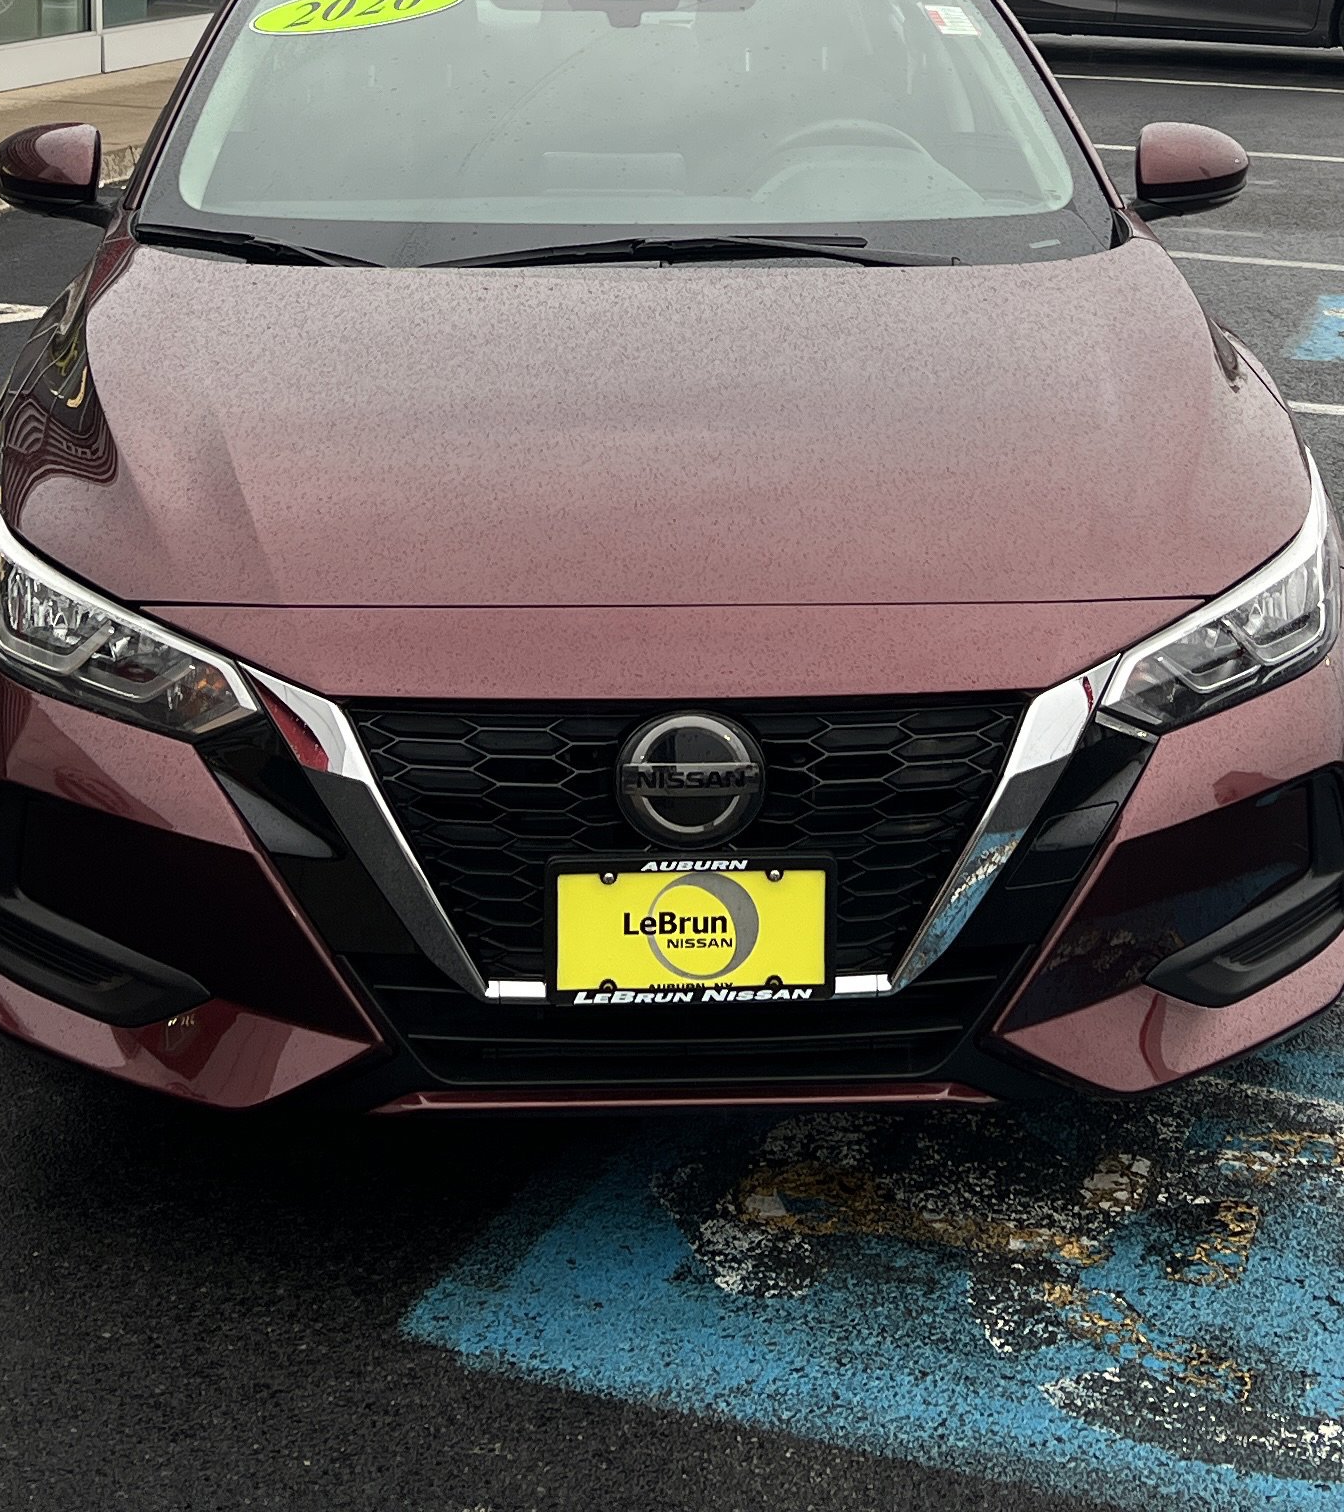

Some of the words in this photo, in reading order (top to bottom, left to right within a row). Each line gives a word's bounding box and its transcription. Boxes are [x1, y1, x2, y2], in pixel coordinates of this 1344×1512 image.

[637, 770, 746, 788] NISSAN
[641, 859, 748, 872] AUBURN
[623, 912, 727, 936] LeBrun
[667, 938, 733, 949] NISSAN
